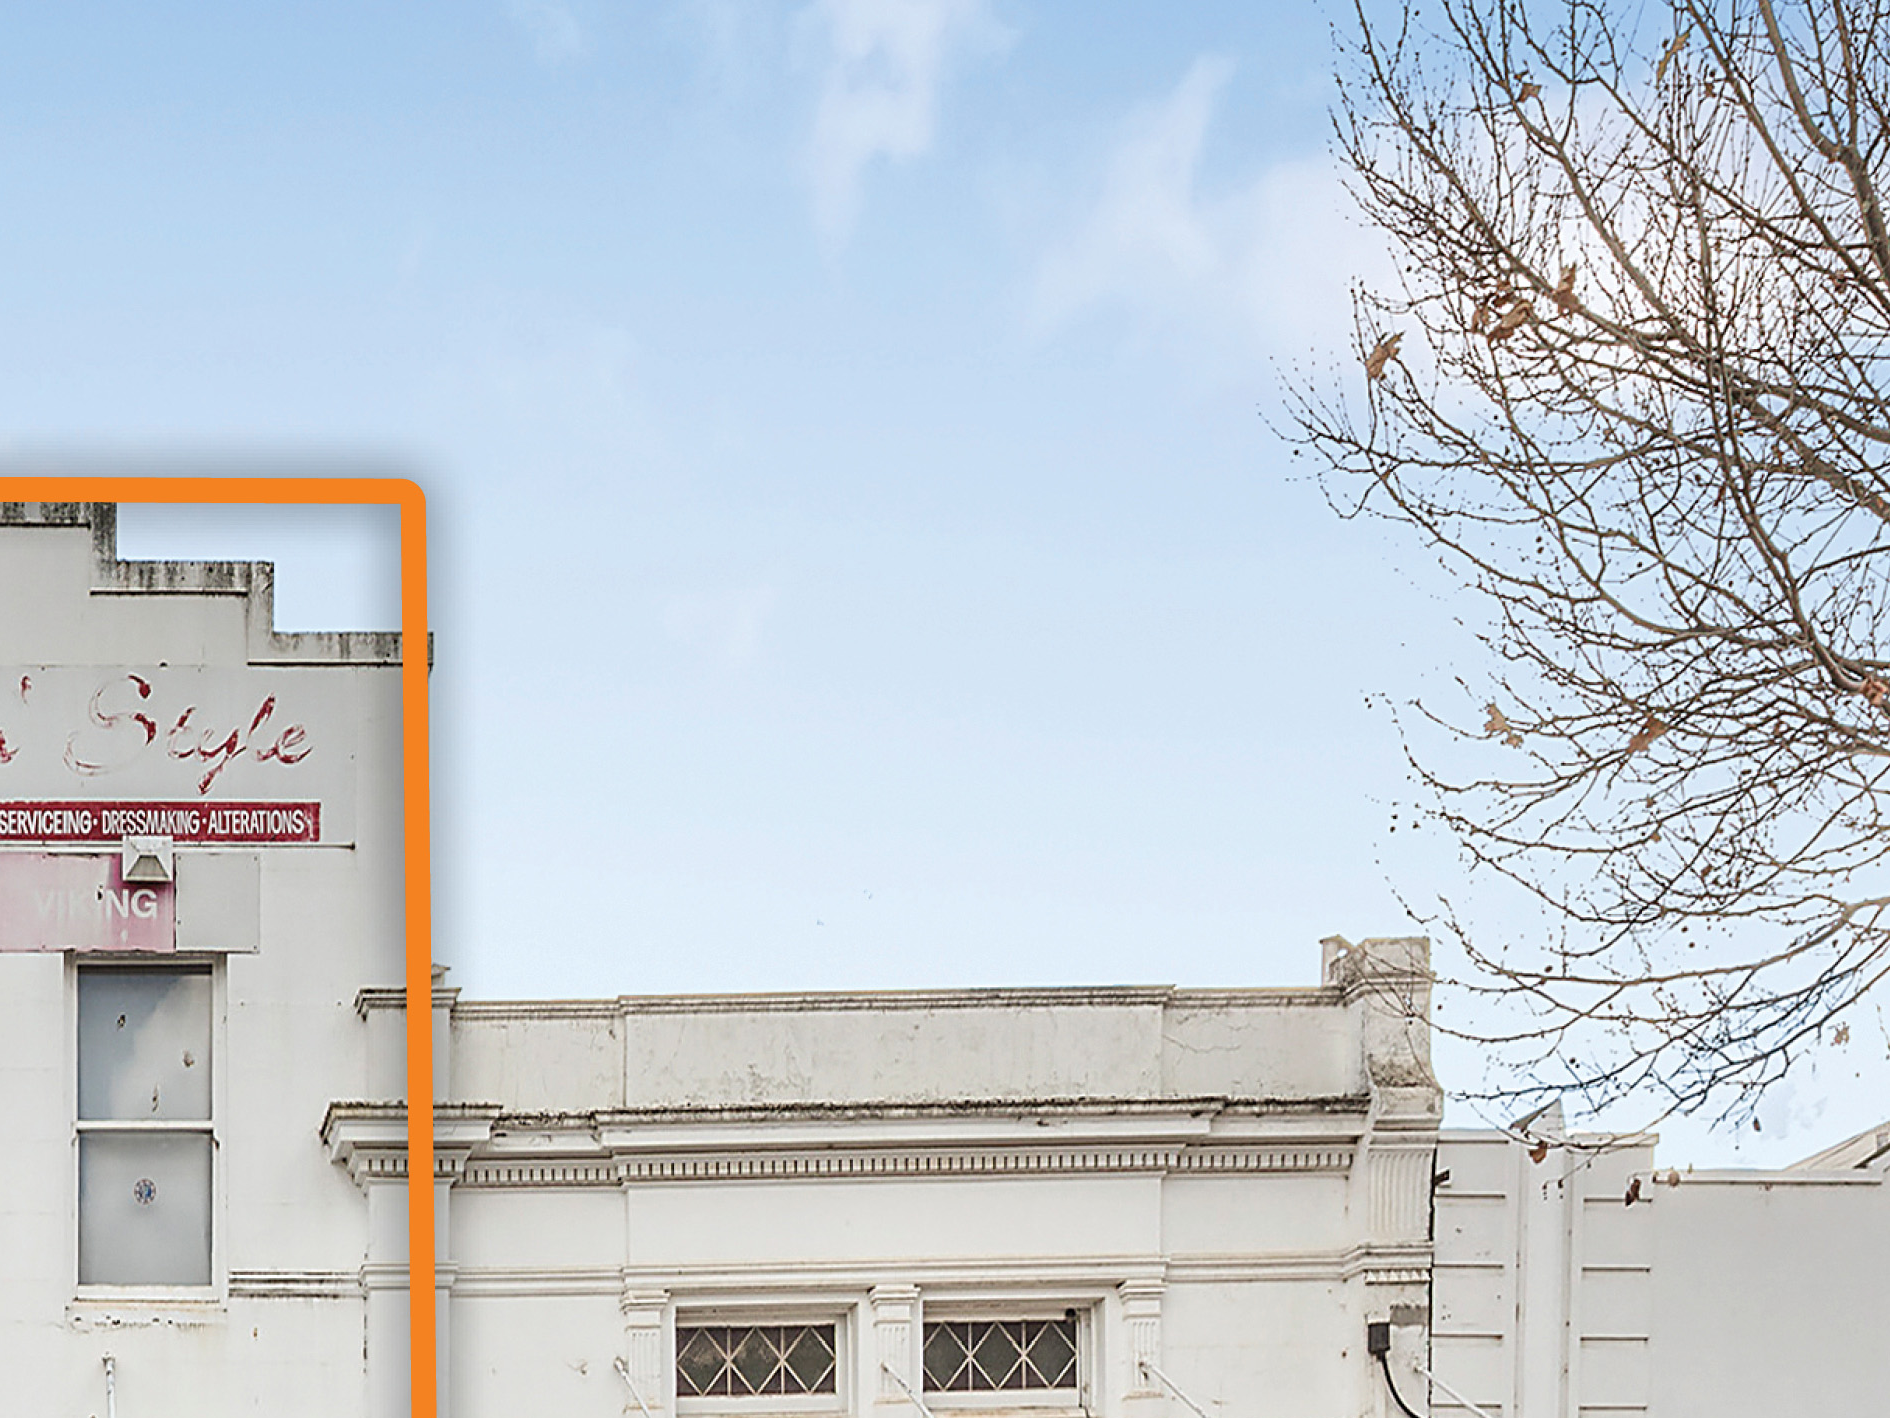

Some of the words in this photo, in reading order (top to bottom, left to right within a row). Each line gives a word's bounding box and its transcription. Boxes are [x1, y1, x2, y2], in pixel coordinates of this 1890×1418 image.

[61, 672, 313, 796] Style
[101, 808, 201, 836] DRESSMAKING
[206, 807, 306, 836] ALTERATIONS
